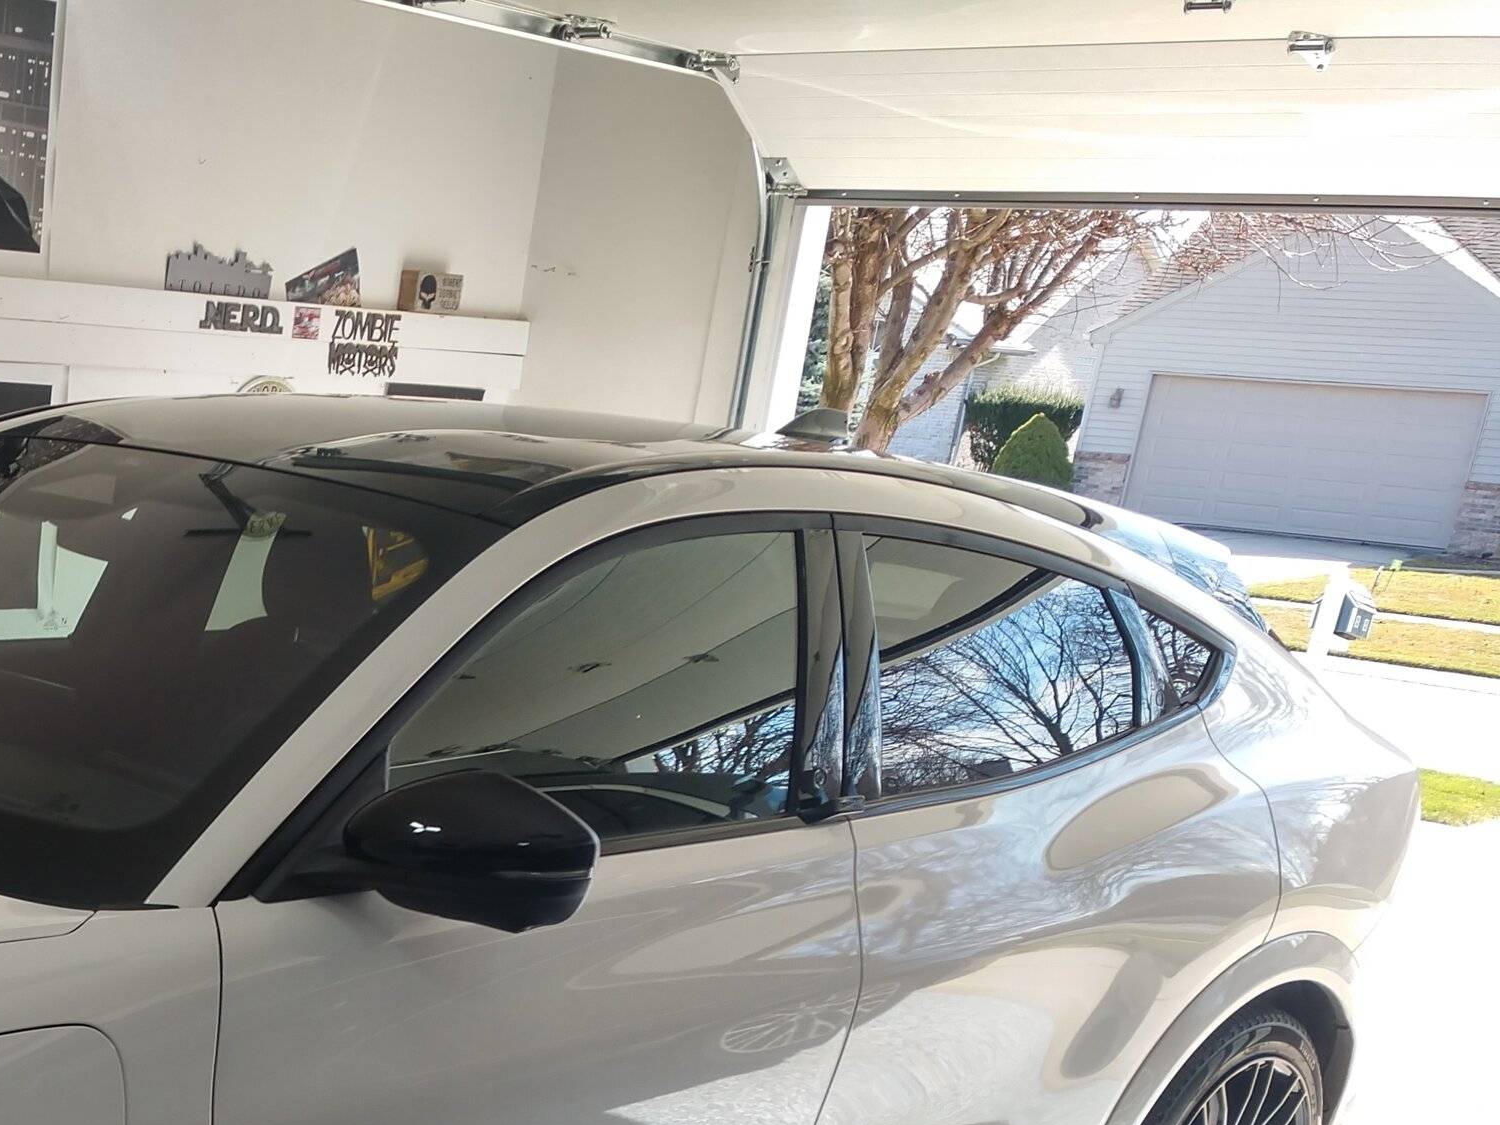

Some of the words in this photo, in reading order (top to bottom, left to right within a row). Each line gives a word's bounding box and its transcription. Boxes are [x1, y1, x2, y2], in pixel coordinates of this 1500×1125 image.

[199, 300, 284, 335] NERD
[331, 309, 402, 344] ZOMBIE
[327, 341, 399, 378] MOTORS
